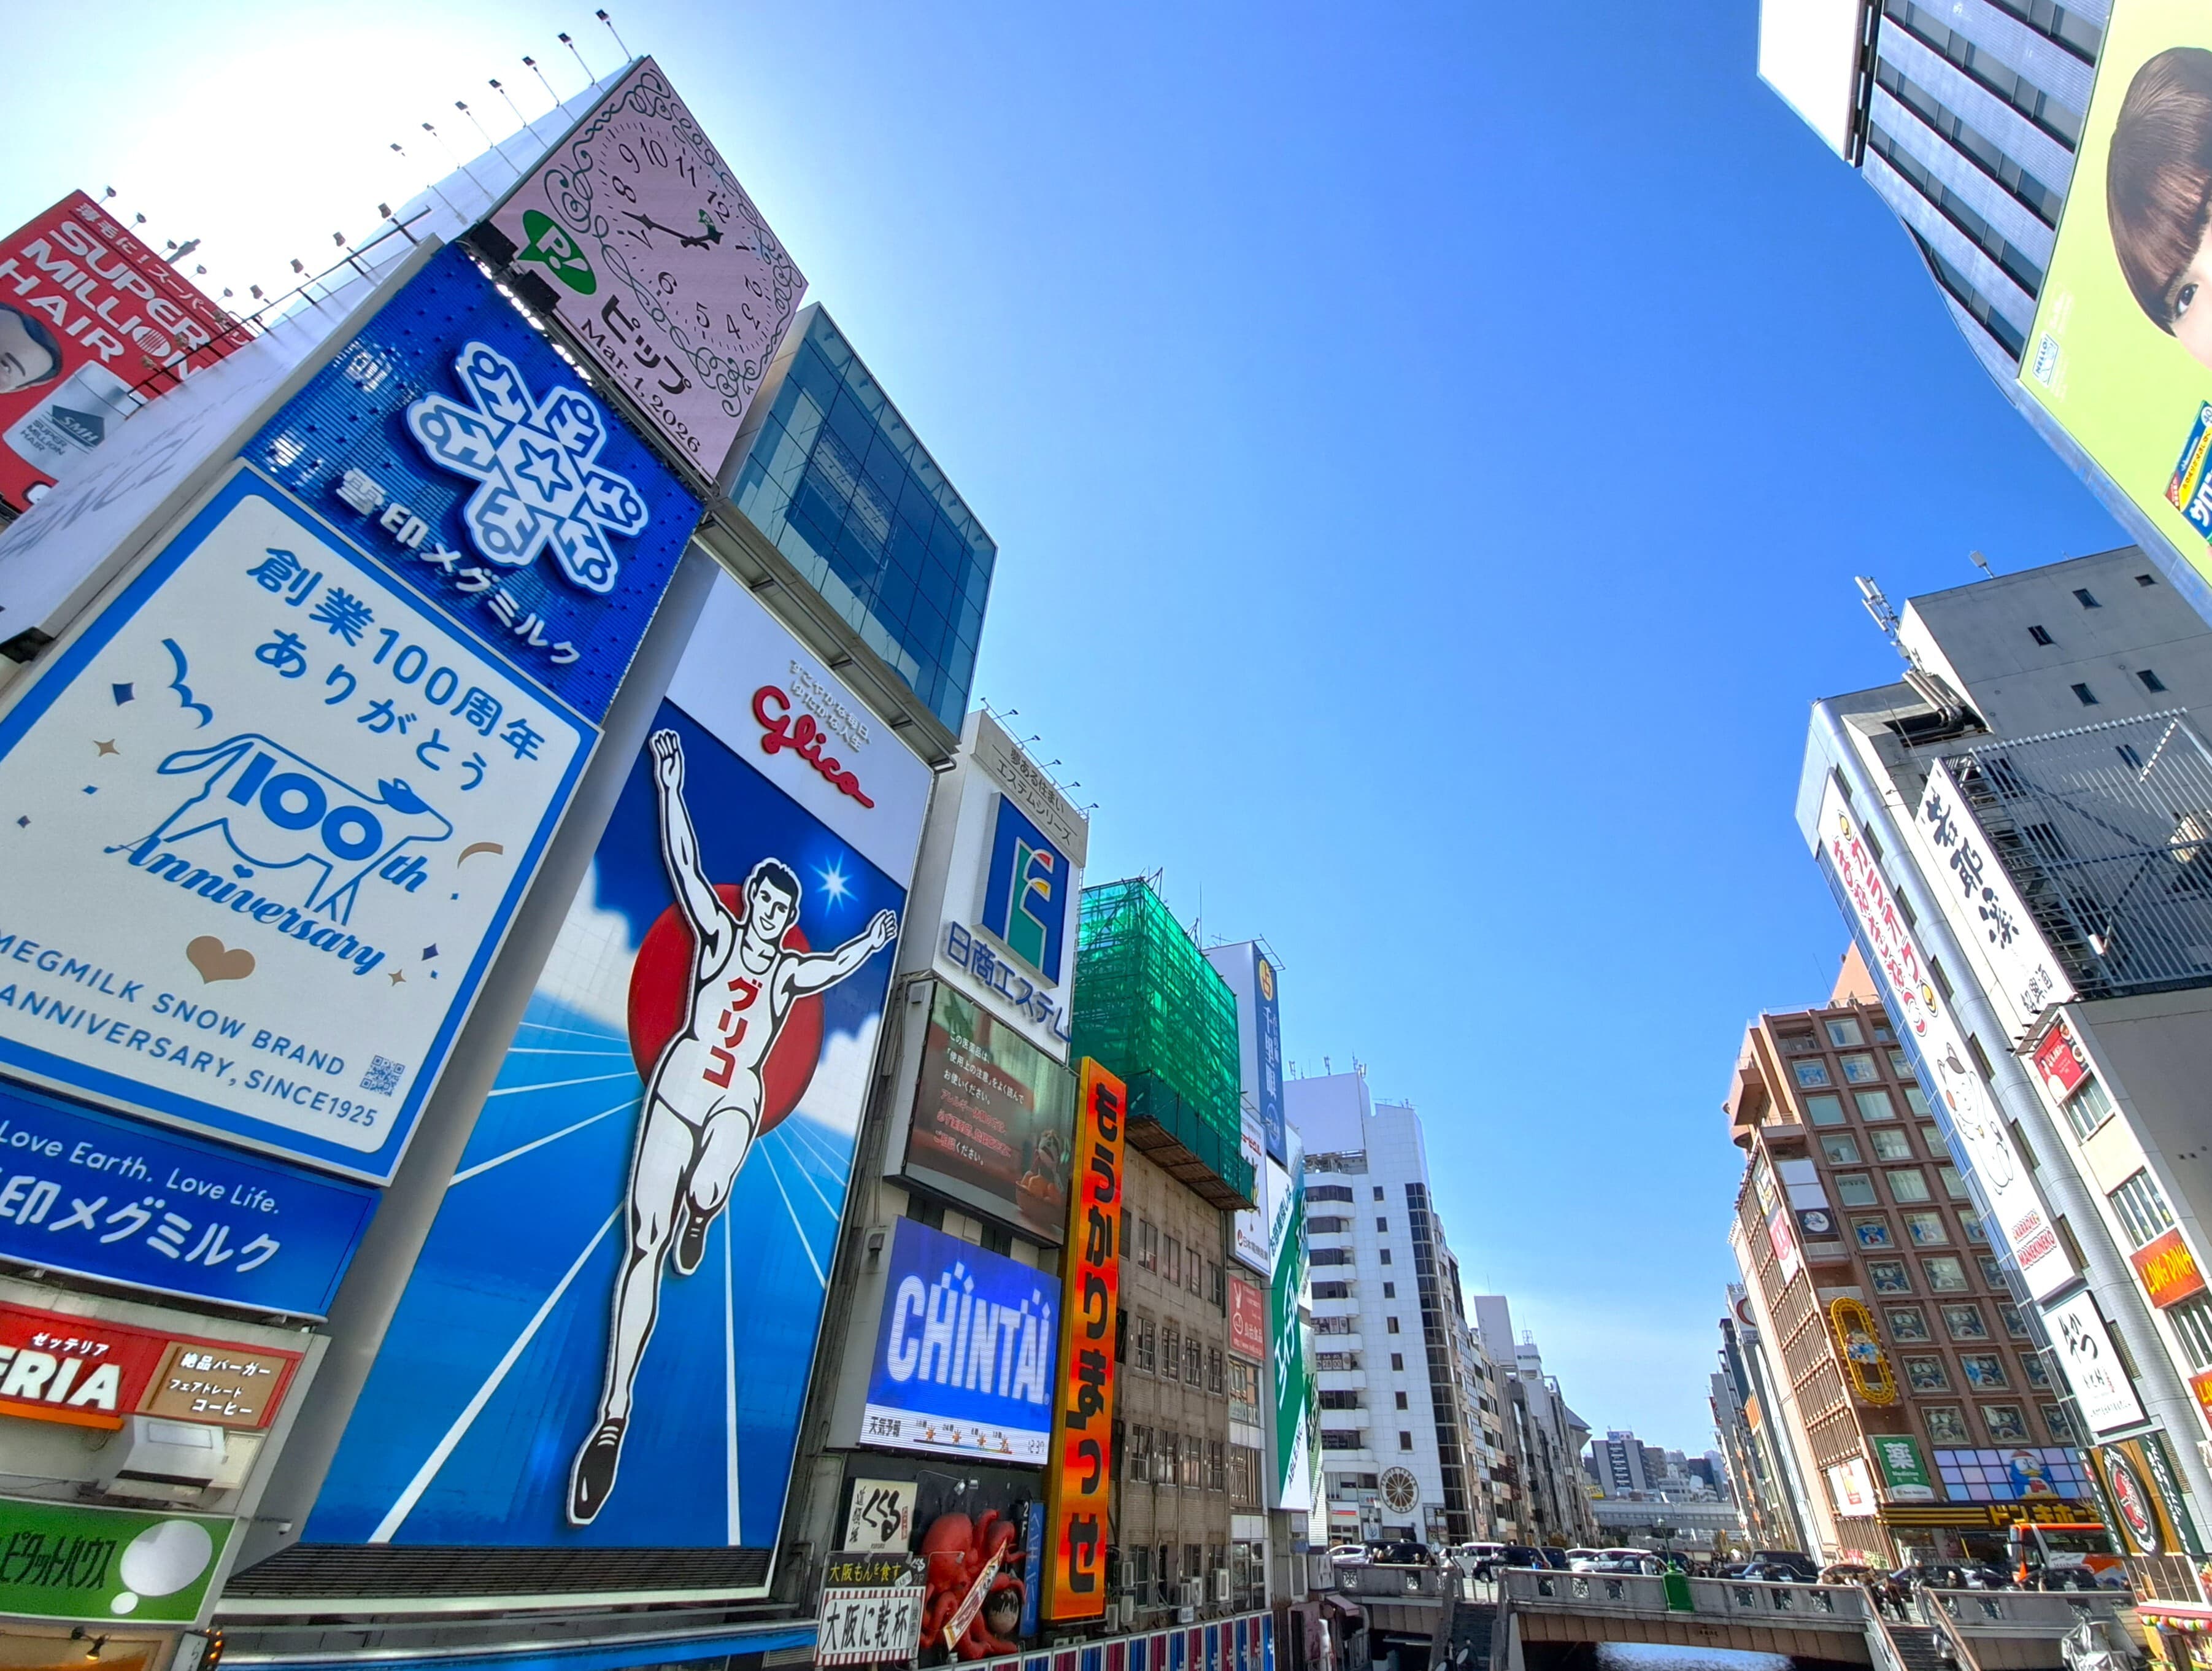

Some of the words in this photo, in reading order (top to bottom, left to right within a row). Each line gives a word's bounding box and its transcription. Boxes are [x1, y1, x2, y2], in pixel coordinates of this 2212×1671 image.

[619, 144, 641, 174] 9
[640, 137, 669, 168] 10
[612, 176, 636, 204] 8
[674, 156, 698, 188] 11
[707, 189, 730, 225] 12
[627, 229, 653, 250] 7
[49, 221, 210, 350] SUPER
[658, 271, 678, 295] 6
[745, 275, 763, 298] 2
[0, 258, 125, 363] HAIR
[696, 301, 710, 330] 5
[726, 314, 742, 340] 4
[741, 303, 760, 331] 3
[601, 295, 692, 395] ピップ
[581, 318, 628, 377] Mar.
[649, 395, 701, 453] 2026
[20, 430, 45, 452] HAIR
[27, 425, 65, 455] MILLION
[33, 420, 67, 447] SUPER
[62, 416, 99, 442] SMH
[2190, 468, 2212, 527] サロ
[336, 467, 581, 665] 雪印メグミルク
[247, 548, 546, 764] 創業100周年
[255, 629, 488, 792] ありがとう
[752, 685, 874, 809] Glico
[1011, 747, 1063, 812] 夢ある住まい
[997, 760, 1071, 846] エステムシリーズ
[226, 751, 383, 860] 100
[379, 854, 428, 893] th
[104, 835, 387, 976] Anniversary
[1851, 836, 1920, 981] カラオケ
[152, 994, 246, 1039] SNOW
[251, 1029, 345, 1076] BRAND
[702, 976, 763, 1089] グリコ
[950, 1031, 990, 1063] この医薬品は、
[0, 984, 238, 1087] ANNIVERSARY,
[244, 1069, 378, 1127] SINCE1925
[944, 1069, 990, 1105] お使いください。
[0, 1120, 63, 1156] Love
[69, 1141, 152, 1183] Earth.
[166, 1168, 225, 1200] Love
[231, 1187, 279, 1214] Life.
[33, 1332, 109, 1356] ゼッテリア
[887, 1261, 1050, 1404] CHINTAI
[180, 1352, 271, 1378] 絶品バーガー
[168, 1378, 243, 1397] フェアトレード
[191, 1399, 252, 1416] コーヒー
[869, 1416, 901, 1437] 天気予報
[1883, 1443, 1915, 1468] 薬
[1, 1532, 118, 1589] ピタットハウス
[828, 1561, 902, 1582] 大阪もんを食す
[822, 1599, 909, 1651] 大阪に乾杯
